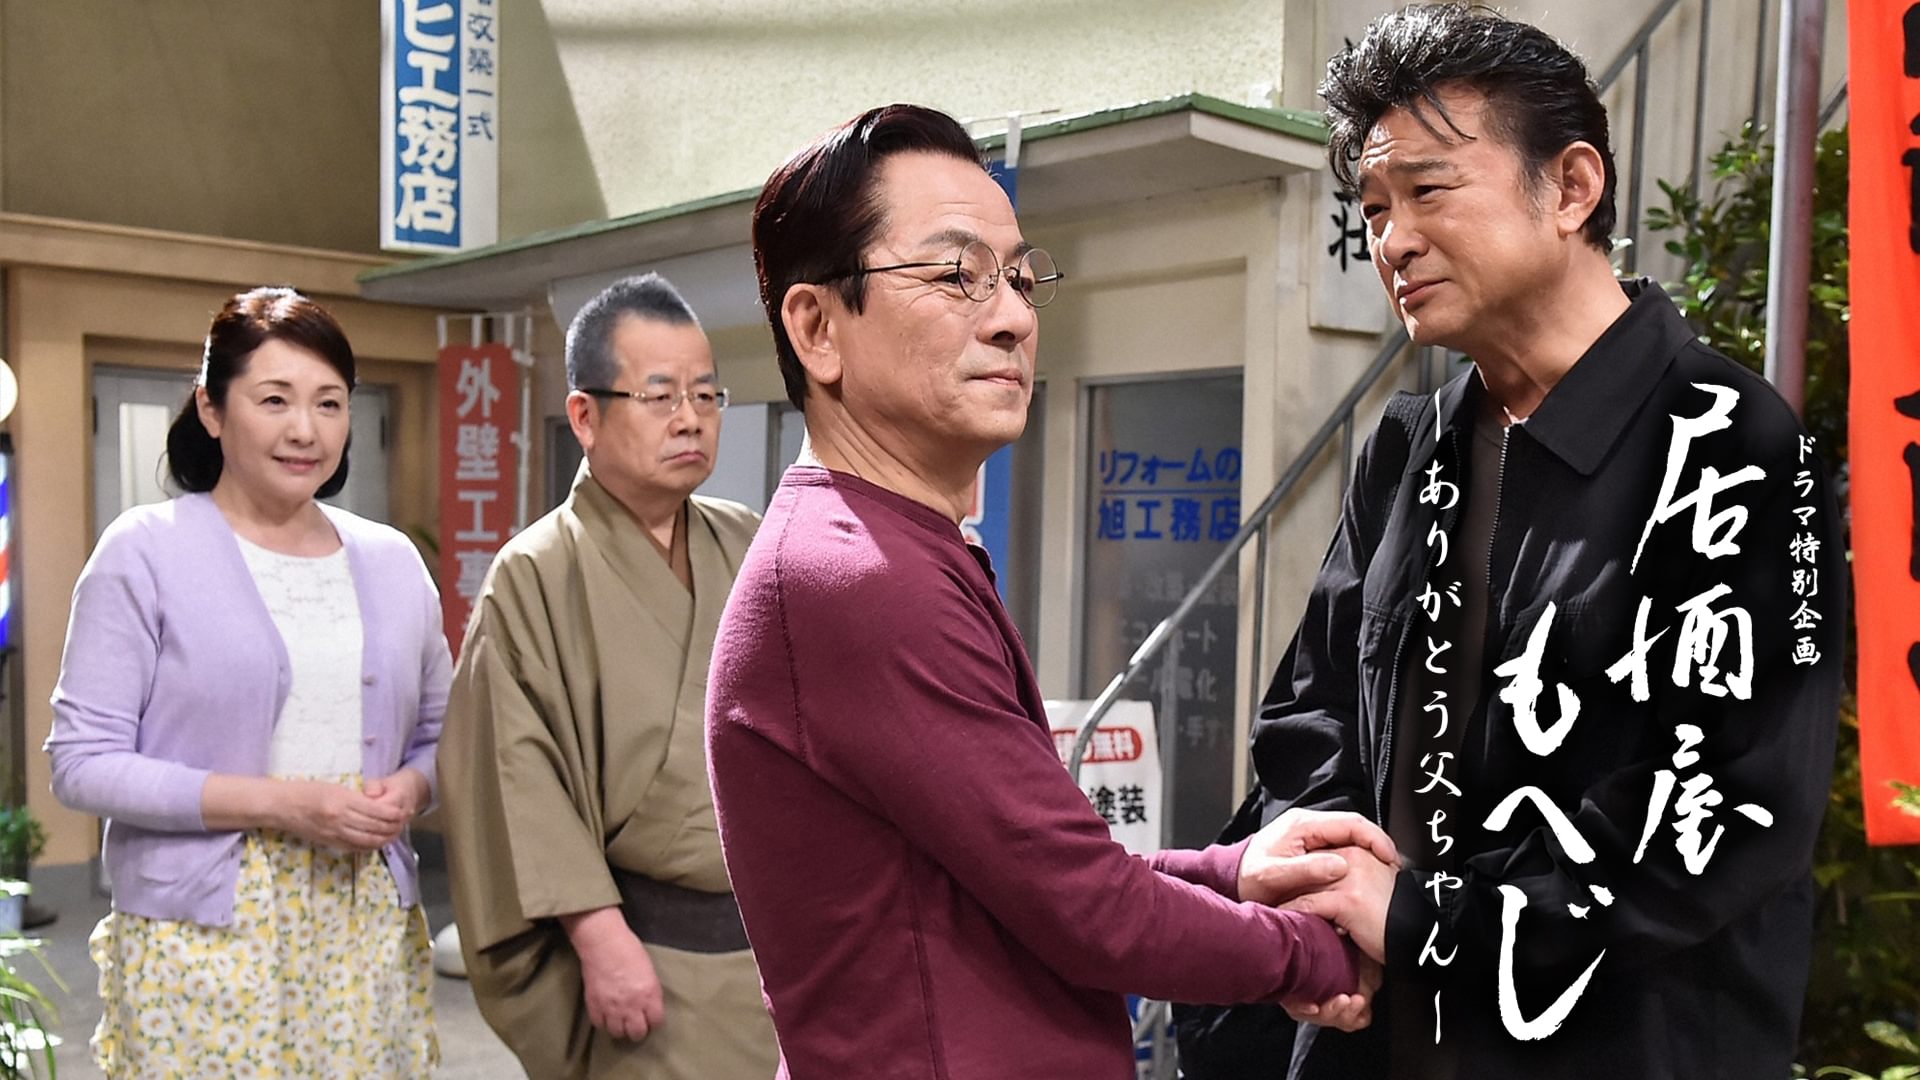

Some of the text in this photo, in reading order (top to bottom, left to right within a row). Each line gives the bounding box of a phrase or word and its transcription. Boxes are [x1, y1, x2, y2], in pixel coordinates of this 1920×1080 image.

[1100, 448, 1241, 485] リフォームの
[1099, 498, 1241, 542] 旭工務店
